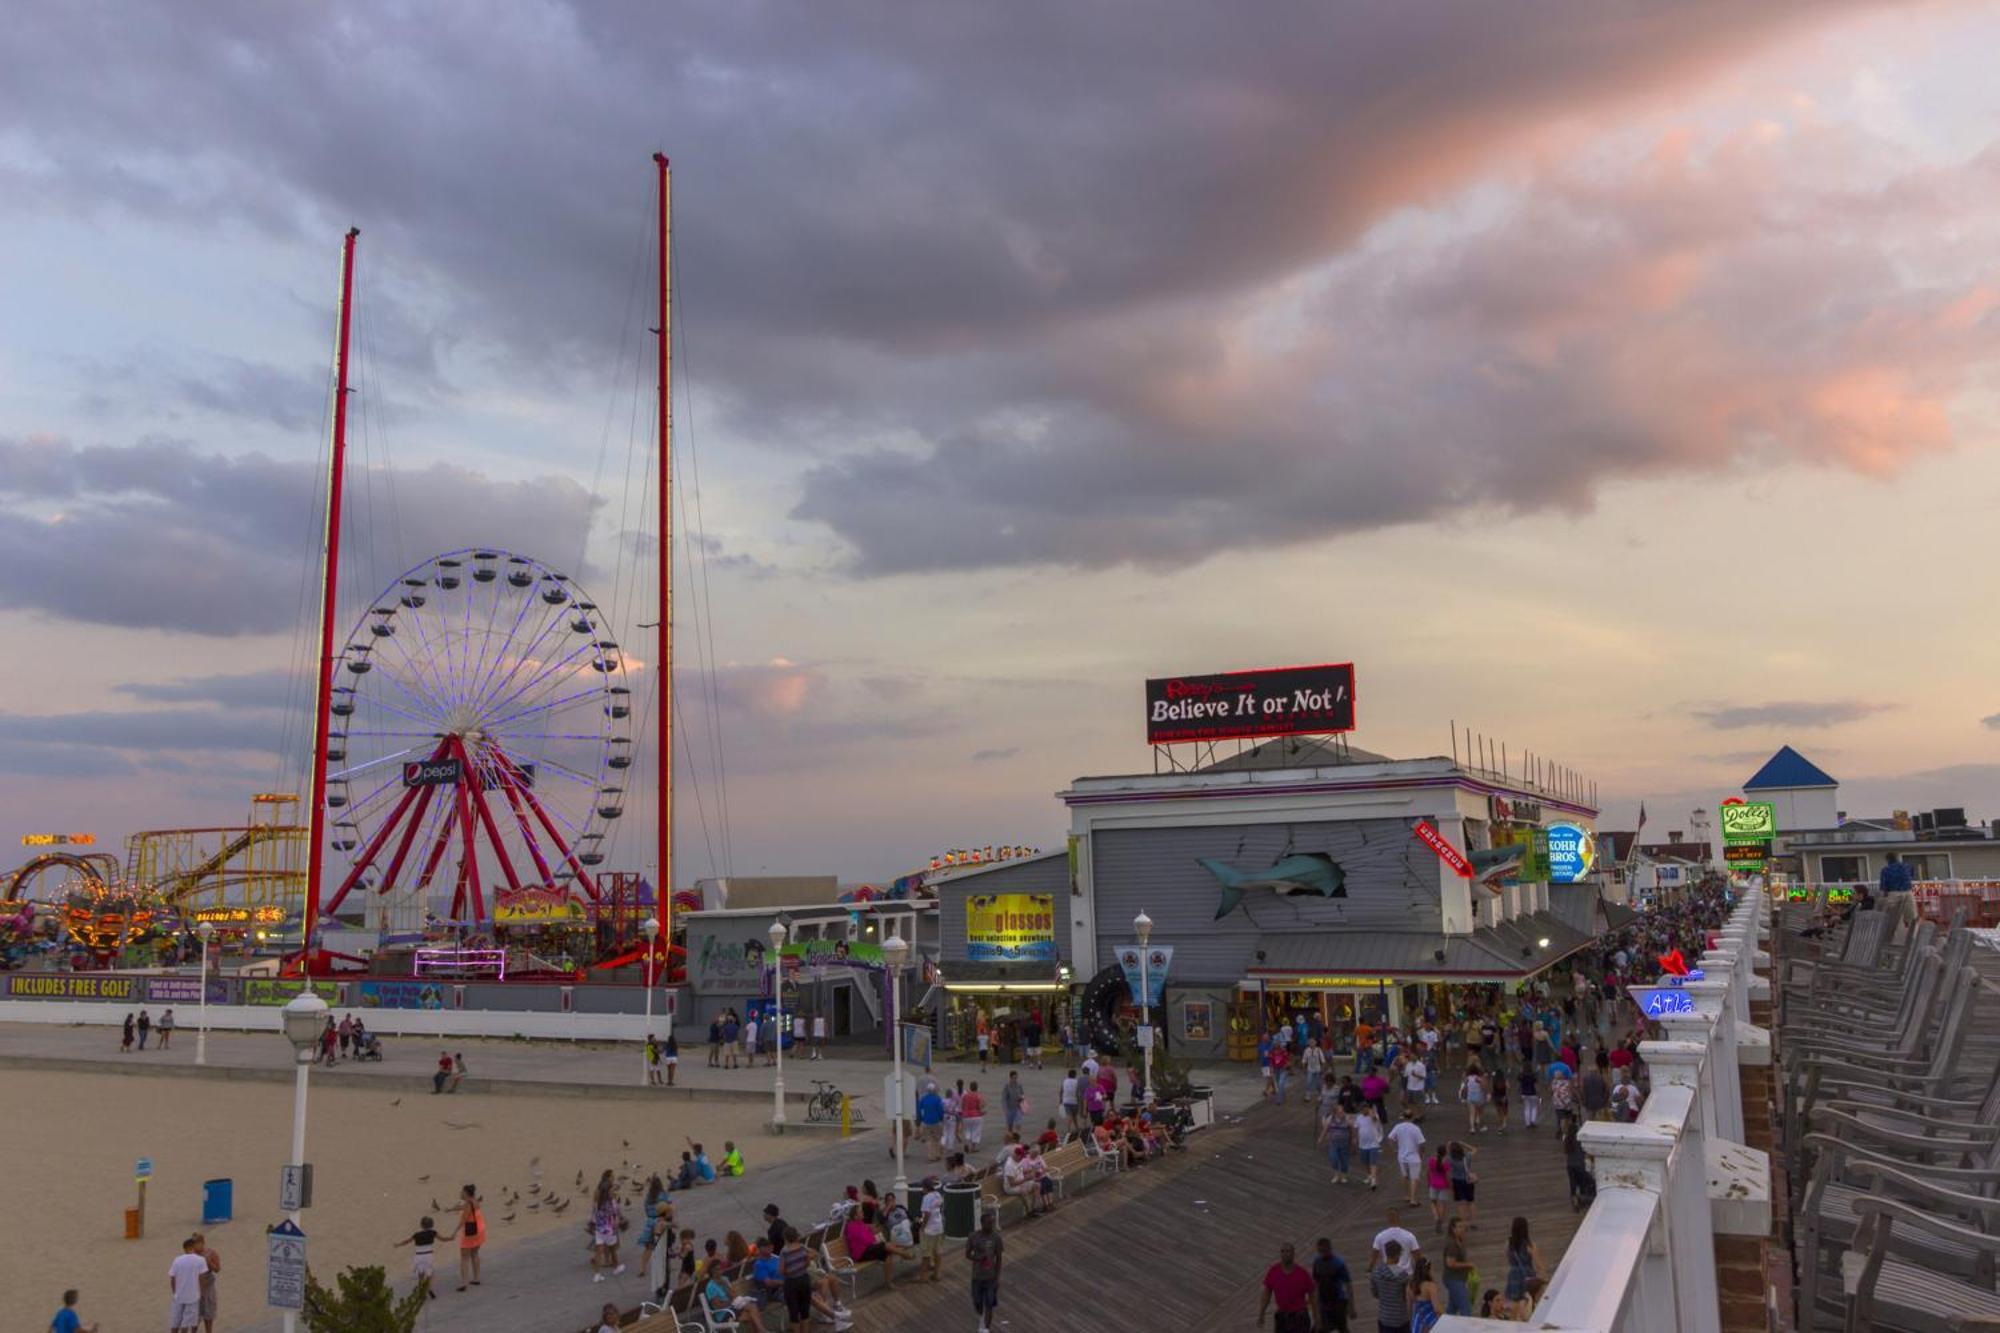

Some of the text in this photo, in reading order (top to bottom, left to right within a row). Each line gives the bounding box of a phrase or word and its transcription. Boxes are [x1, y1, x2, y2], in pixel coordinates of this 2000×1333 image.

[1151, 699, 1229, 722] Believe
[1235, 694, 1256, 716] It
[1263, 697, 1288, 713] or
[423, 765, 456, 779] pepsi
[1549, 840, 1576, 851] KOHR
[1549, 852, 1576, 862] BROS
[11, 977, 66, 995] INCLUDES
[69, 978, 97, 996] FREE
[101, 979, 131, 997] GOLF
